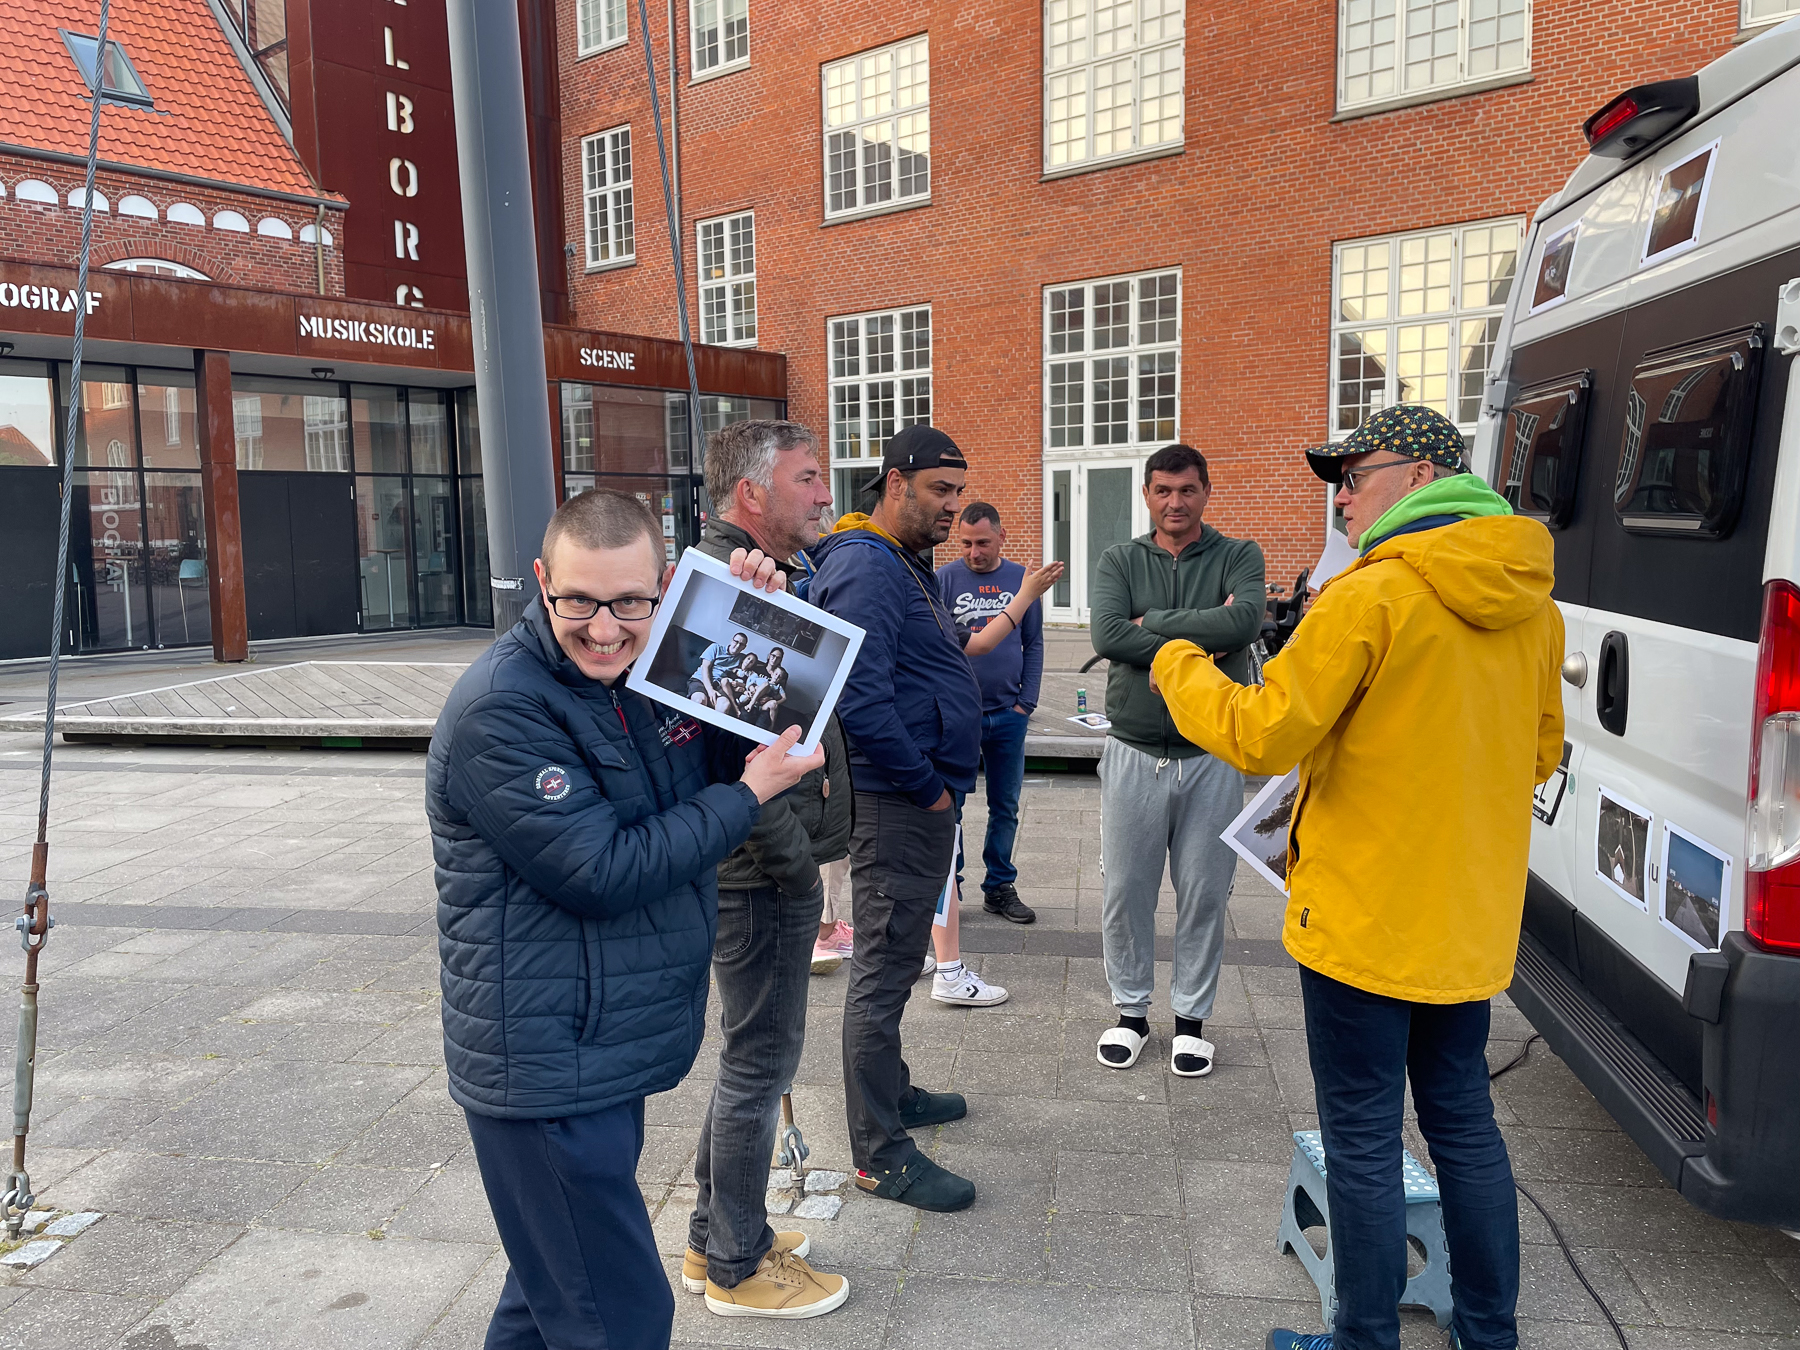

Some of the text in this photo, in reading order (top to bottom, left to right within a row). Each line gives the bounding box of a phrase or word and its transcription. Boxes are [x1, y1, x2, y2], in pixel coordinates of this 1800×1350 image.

[384, 0, 424, 308] LBORG
[299, 315, 435, 350] MUSIKSKOLE
[580, 347, 636, 371] SCENE
[979, 585, 1002, 593] REAL
